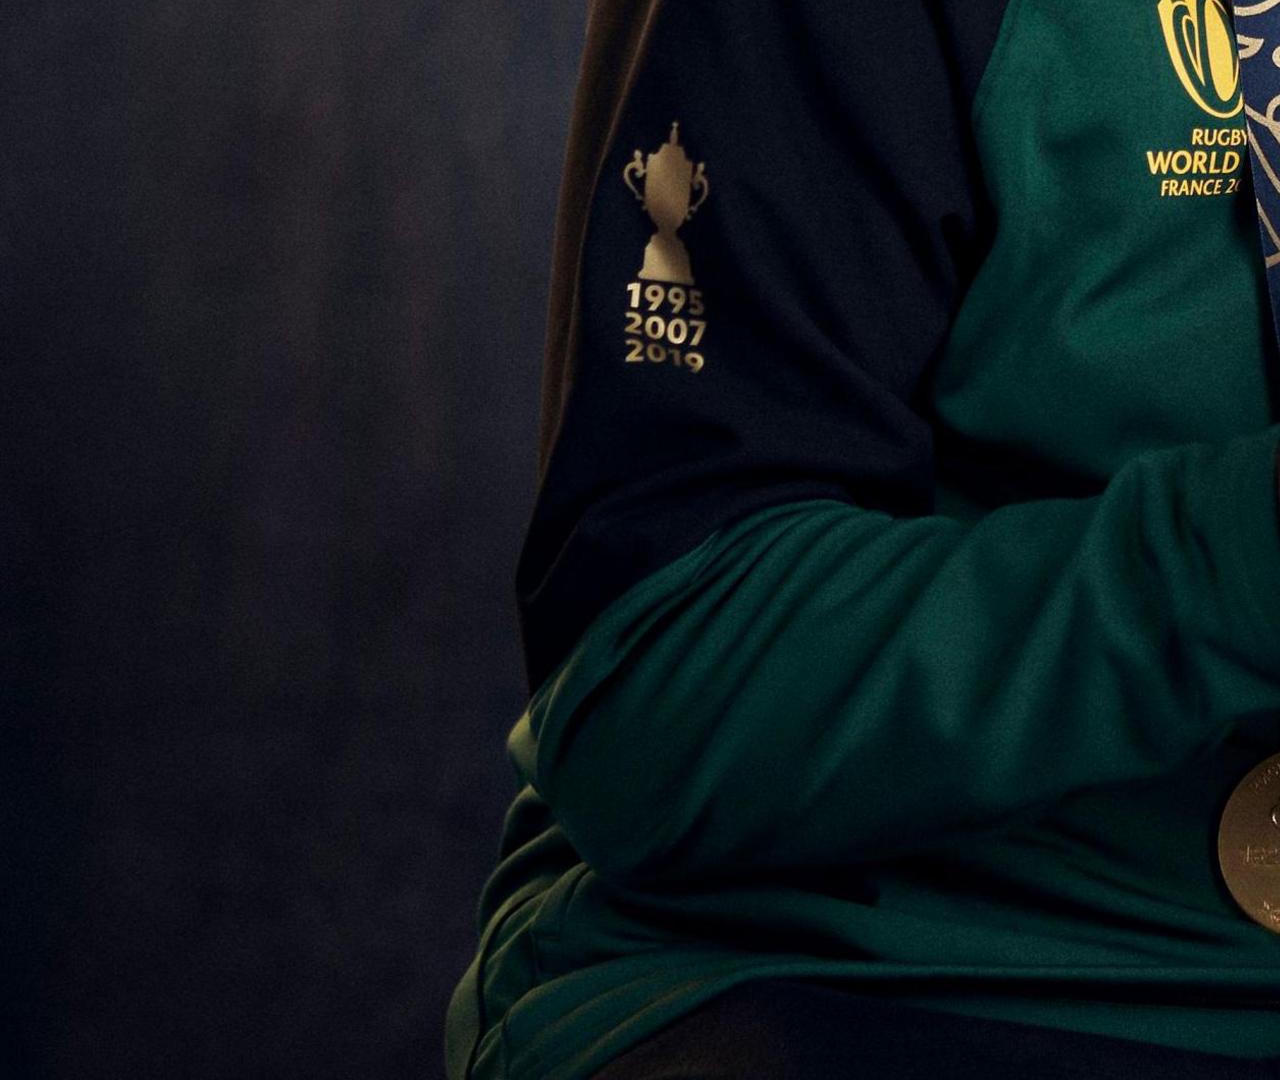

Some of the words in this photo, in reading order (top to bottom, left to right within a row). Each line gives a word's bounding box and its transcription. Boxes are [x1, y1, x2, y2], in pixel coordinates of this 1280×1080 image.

[1191, 128, 1248, 147] RUGBY
[1146, 150, 1240, 176] WORLD
[1160, 178, 1223, 197] FRANCE
[626, 282, 705, 316] 1995
[624, 311, 706, 347] 2007
[624, 339, 705, 374] 2019
